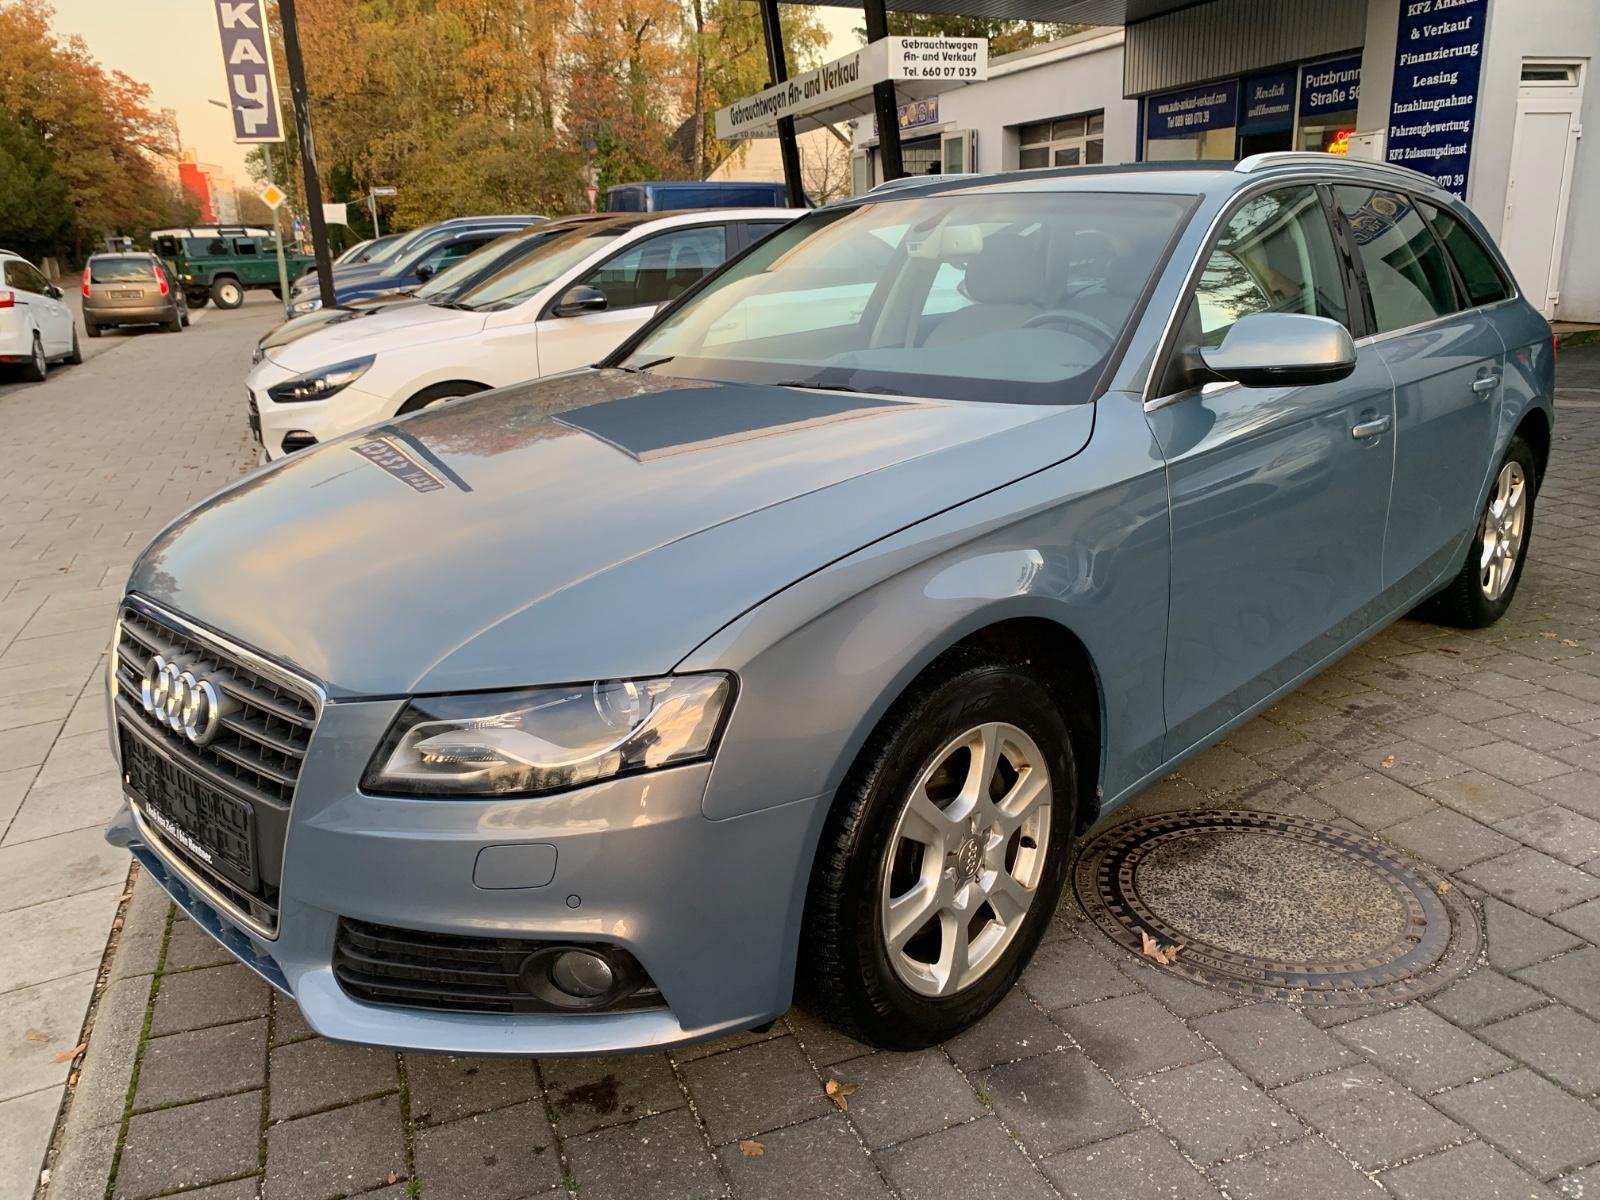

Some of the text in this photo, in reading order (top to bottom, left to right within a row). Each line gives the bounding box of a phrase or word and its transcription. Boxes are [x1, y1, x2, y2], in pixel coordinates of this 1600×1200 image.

[1407, 0, 1479, 17] KFZ Anka
[1410, 16, 1473, 40] & Verkauf
[901, 39, 978, 52] Gebrauchtwagen
[1399, 43, 1479, 66] Finanzierung
[922, 51, 939, 61] und
[942, 51, 977, 61] Verkauf
[903, 66, 977, 77] Tel. 660 07 039
[1412, 71, 1459, 88] Leasing
[730, 92, 787, 126] Gebrauchtwagen
[804, 76, 821, 99] und
[822, 54, 860, 92] Verkauf
[1310, 88, 1346, 107] Straße
[1393, 94, 1473, 114] Inzahlungnahme
[1390, 120, 1470, 138] Fahrzeugbewertung
[1389, 143, 1467, 161] KFZ Zulassungsdienst
[1453, 174, 1464, 186] 39
